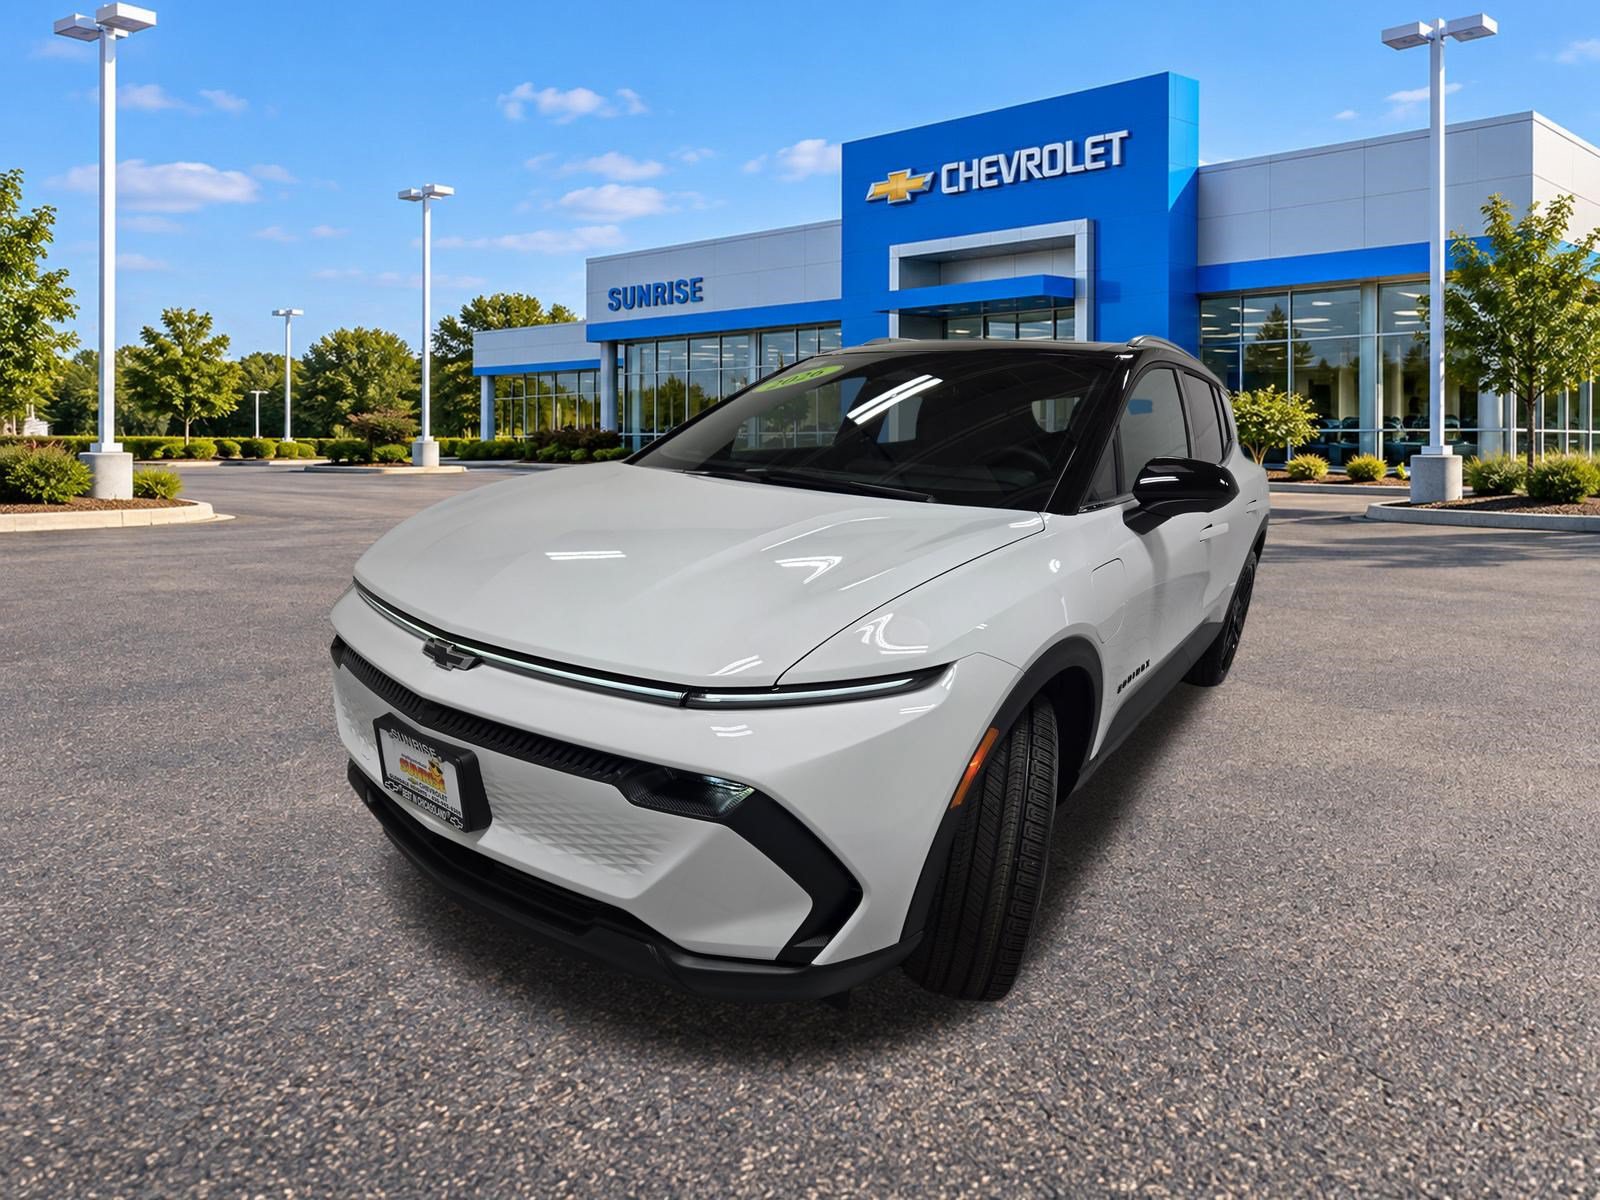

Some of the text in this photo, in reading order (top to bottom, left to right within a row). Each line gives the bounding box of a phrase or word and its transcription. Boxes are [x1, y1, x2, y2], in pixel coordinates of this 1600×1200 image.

[941, 130, 1129, 195] CHEVROLET
[607, 277, 704, 312] SUNRISE
[390, 728, 437, 758] SUNRISE
